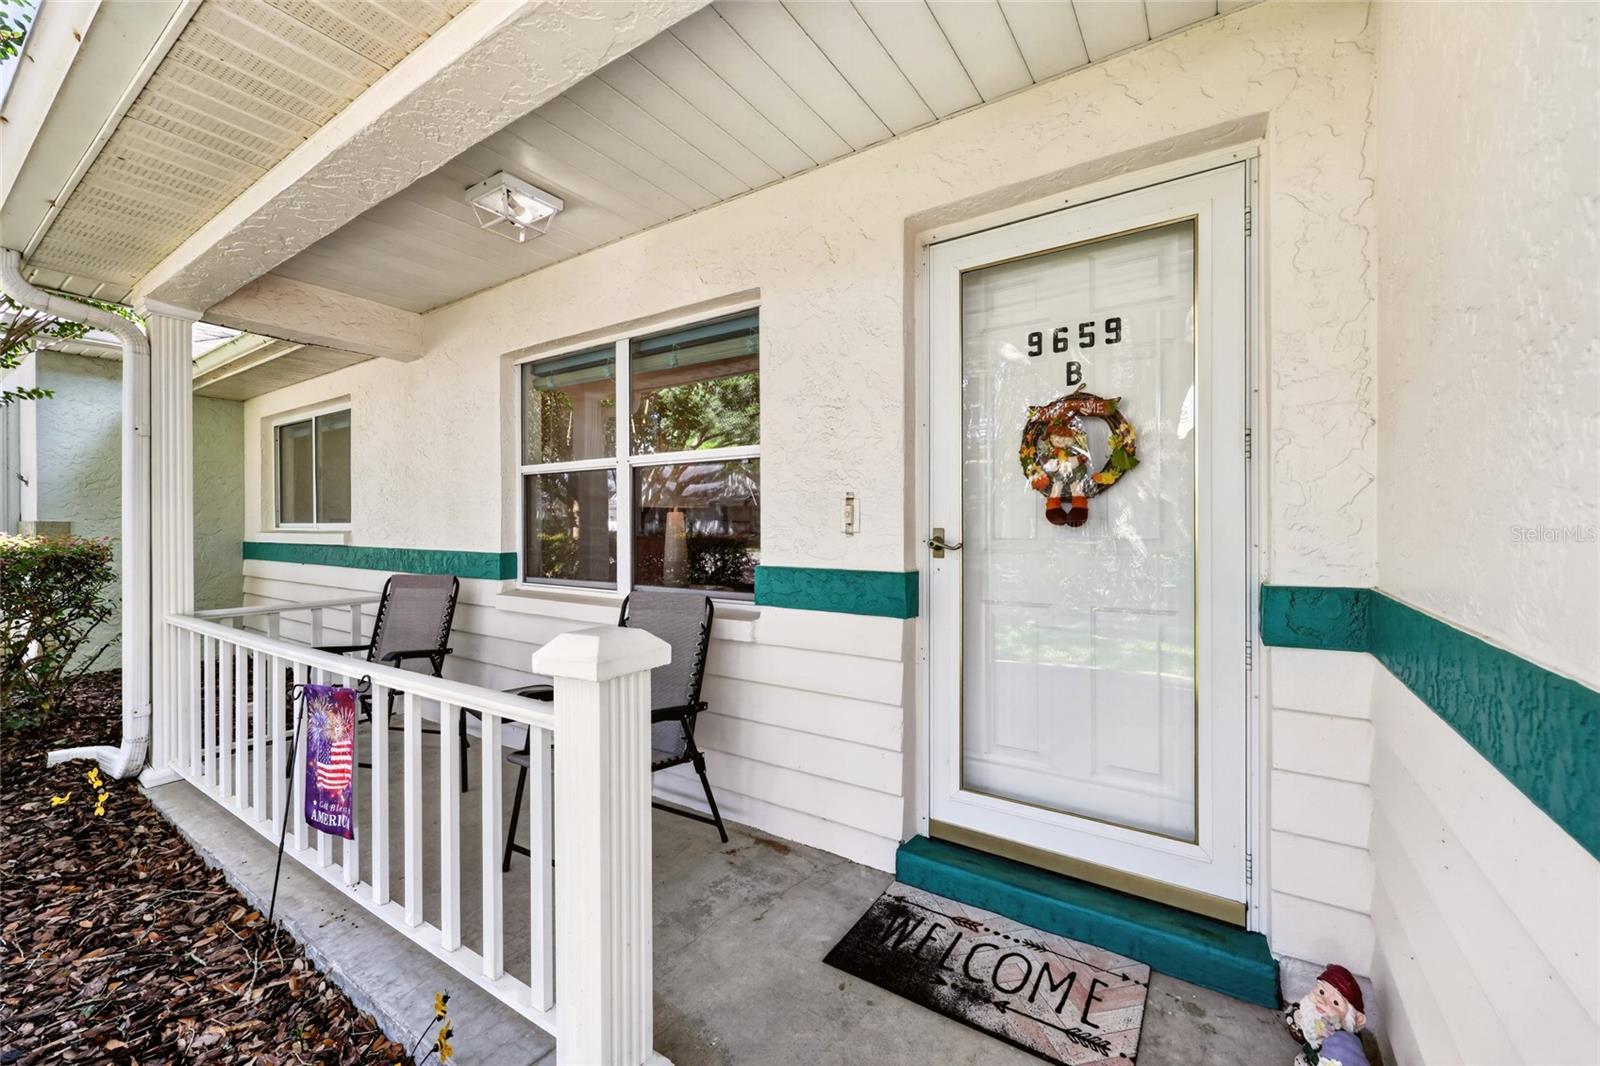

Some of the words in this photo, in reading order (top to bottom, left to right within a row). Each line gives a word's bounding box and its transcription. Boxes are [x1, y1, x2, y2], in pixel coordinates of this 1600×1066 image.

[1027, 317, 1122, 357] 9659
[1066, 361, 1082, 386] B
[880, 914, 1109, 1029] WELCOME
